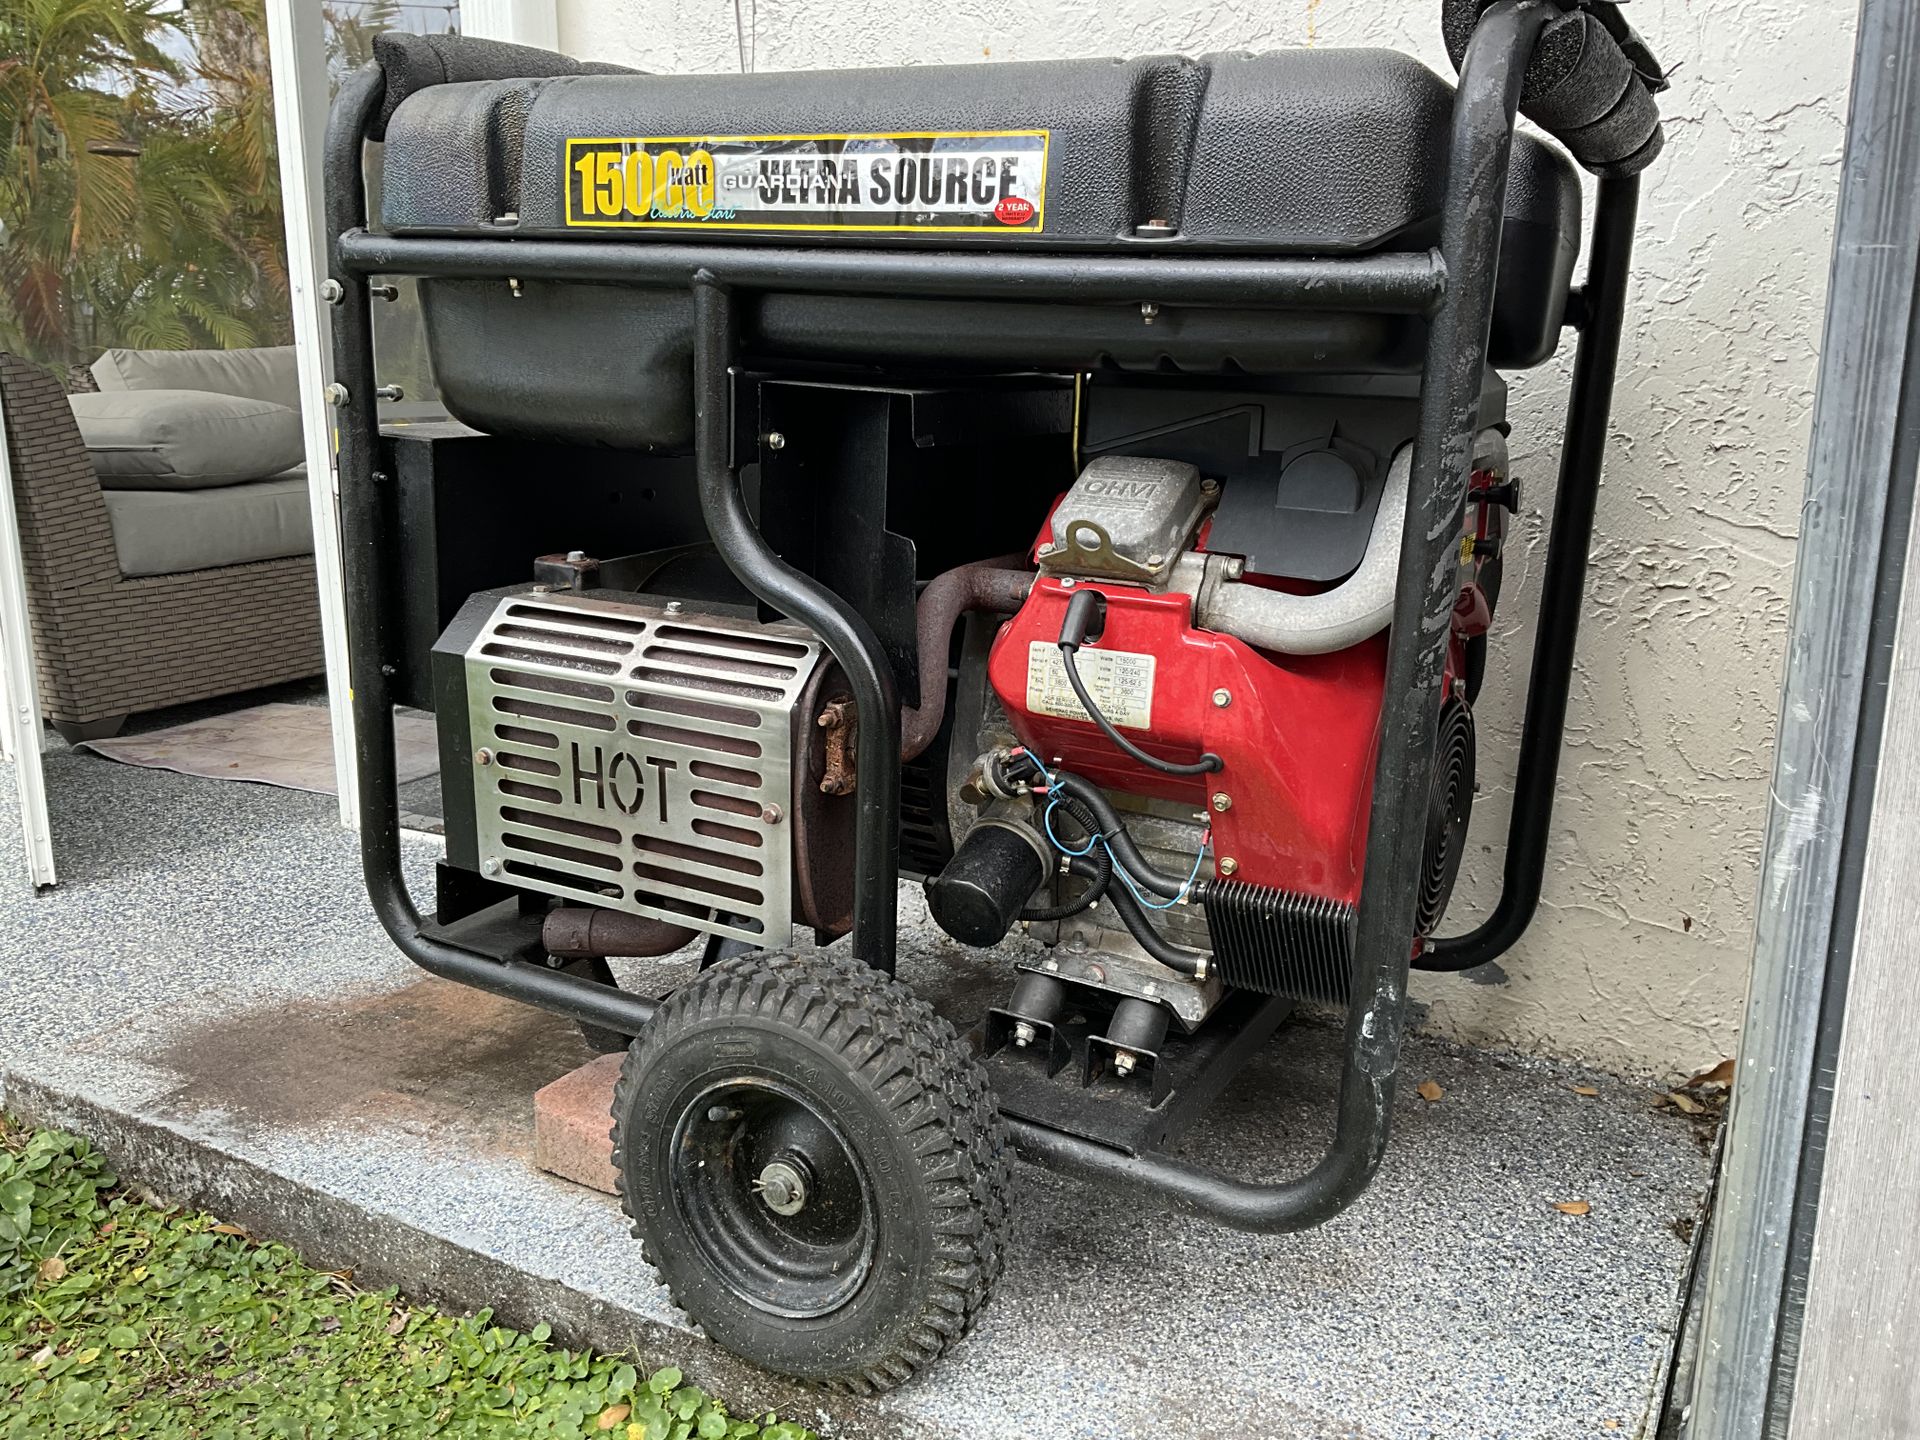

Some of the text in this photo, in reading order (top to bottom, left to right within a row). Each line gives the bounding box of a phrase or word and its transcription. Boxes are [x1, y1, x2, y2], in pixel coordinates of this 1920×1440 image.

[575, 149, 714, 217] 15000
[671, 164, 708, 186] watt
[724, 173, 839, 191] GUARDIAN
[759, 156, 1018, 206] ULTRA SOURCE
[702, 200, 742, 221] Start
[998, 203, 1030, 211] 2 YEAR
[1084, 480, 1158, 498] OHVI
[571, 742, 677, 824] HOT
